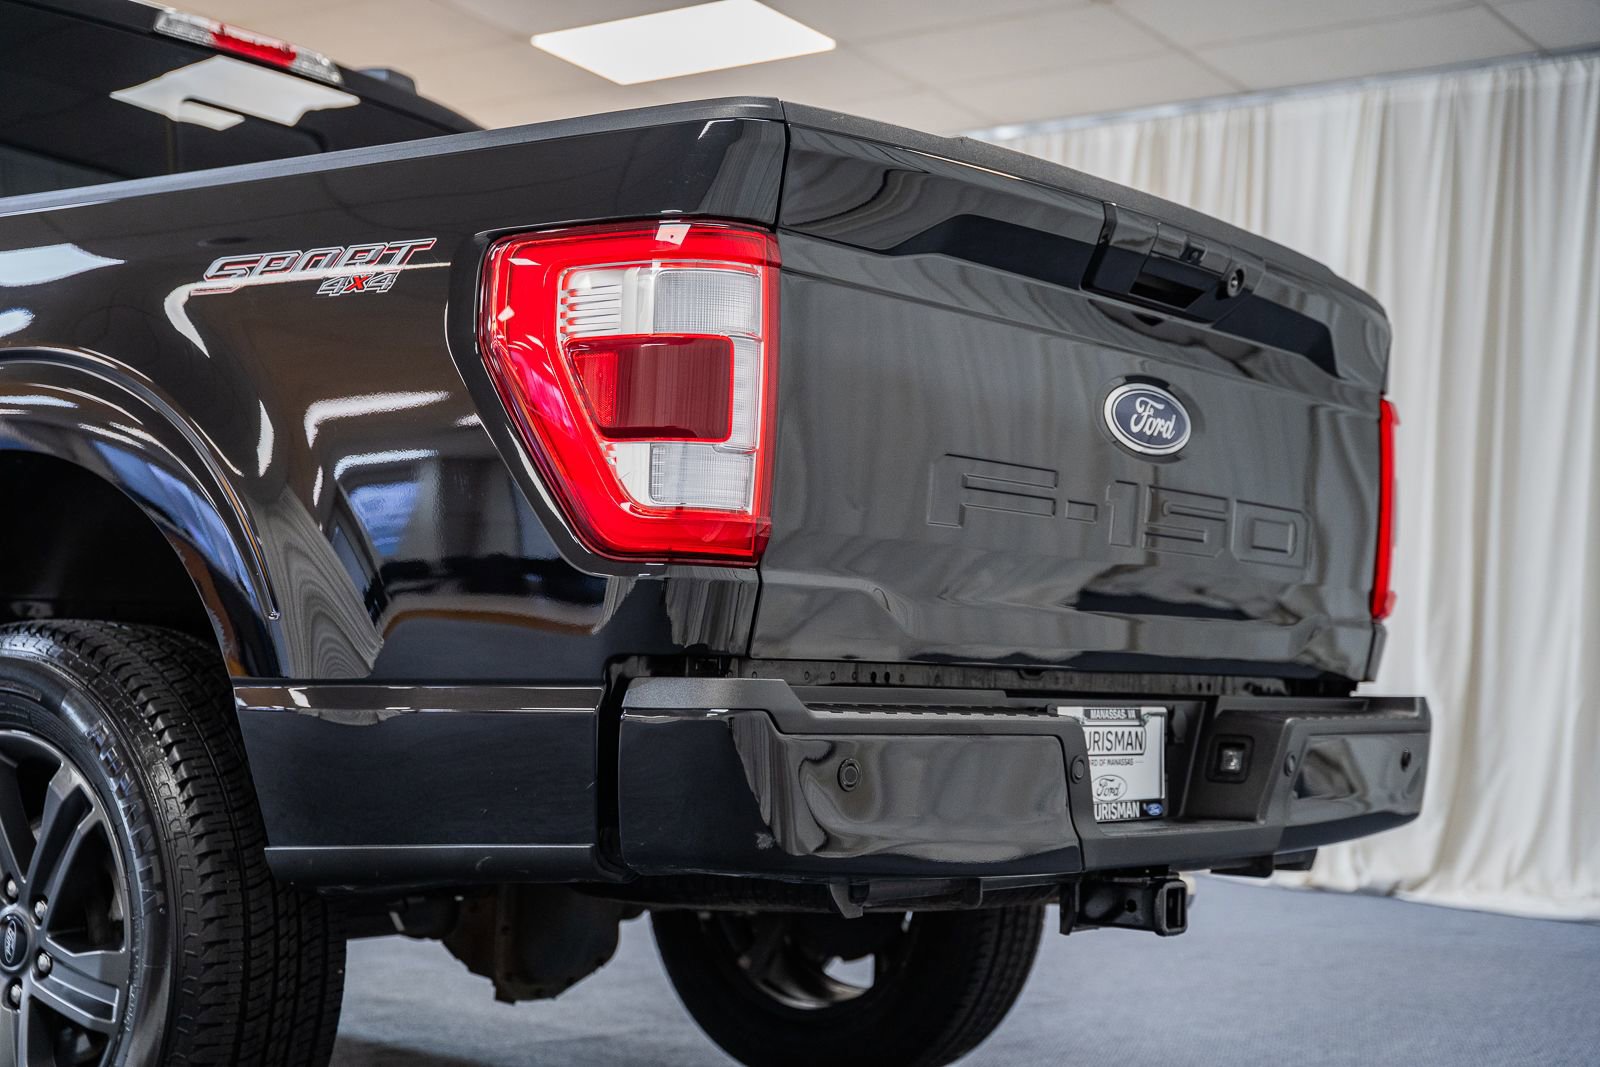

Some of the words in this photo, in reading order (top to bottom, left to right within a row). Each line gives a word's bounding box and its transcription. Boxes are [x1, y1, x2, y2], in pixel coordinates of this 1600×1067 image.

[1129, 396, 1177, 440] Ford
[927, 453, 1313, 569] F-150
[1087, 730, 1144, 752] URISMAN
[1096, 777, 1122, 797] Ford
[1093, 801, 1140, 820] URISMAN
